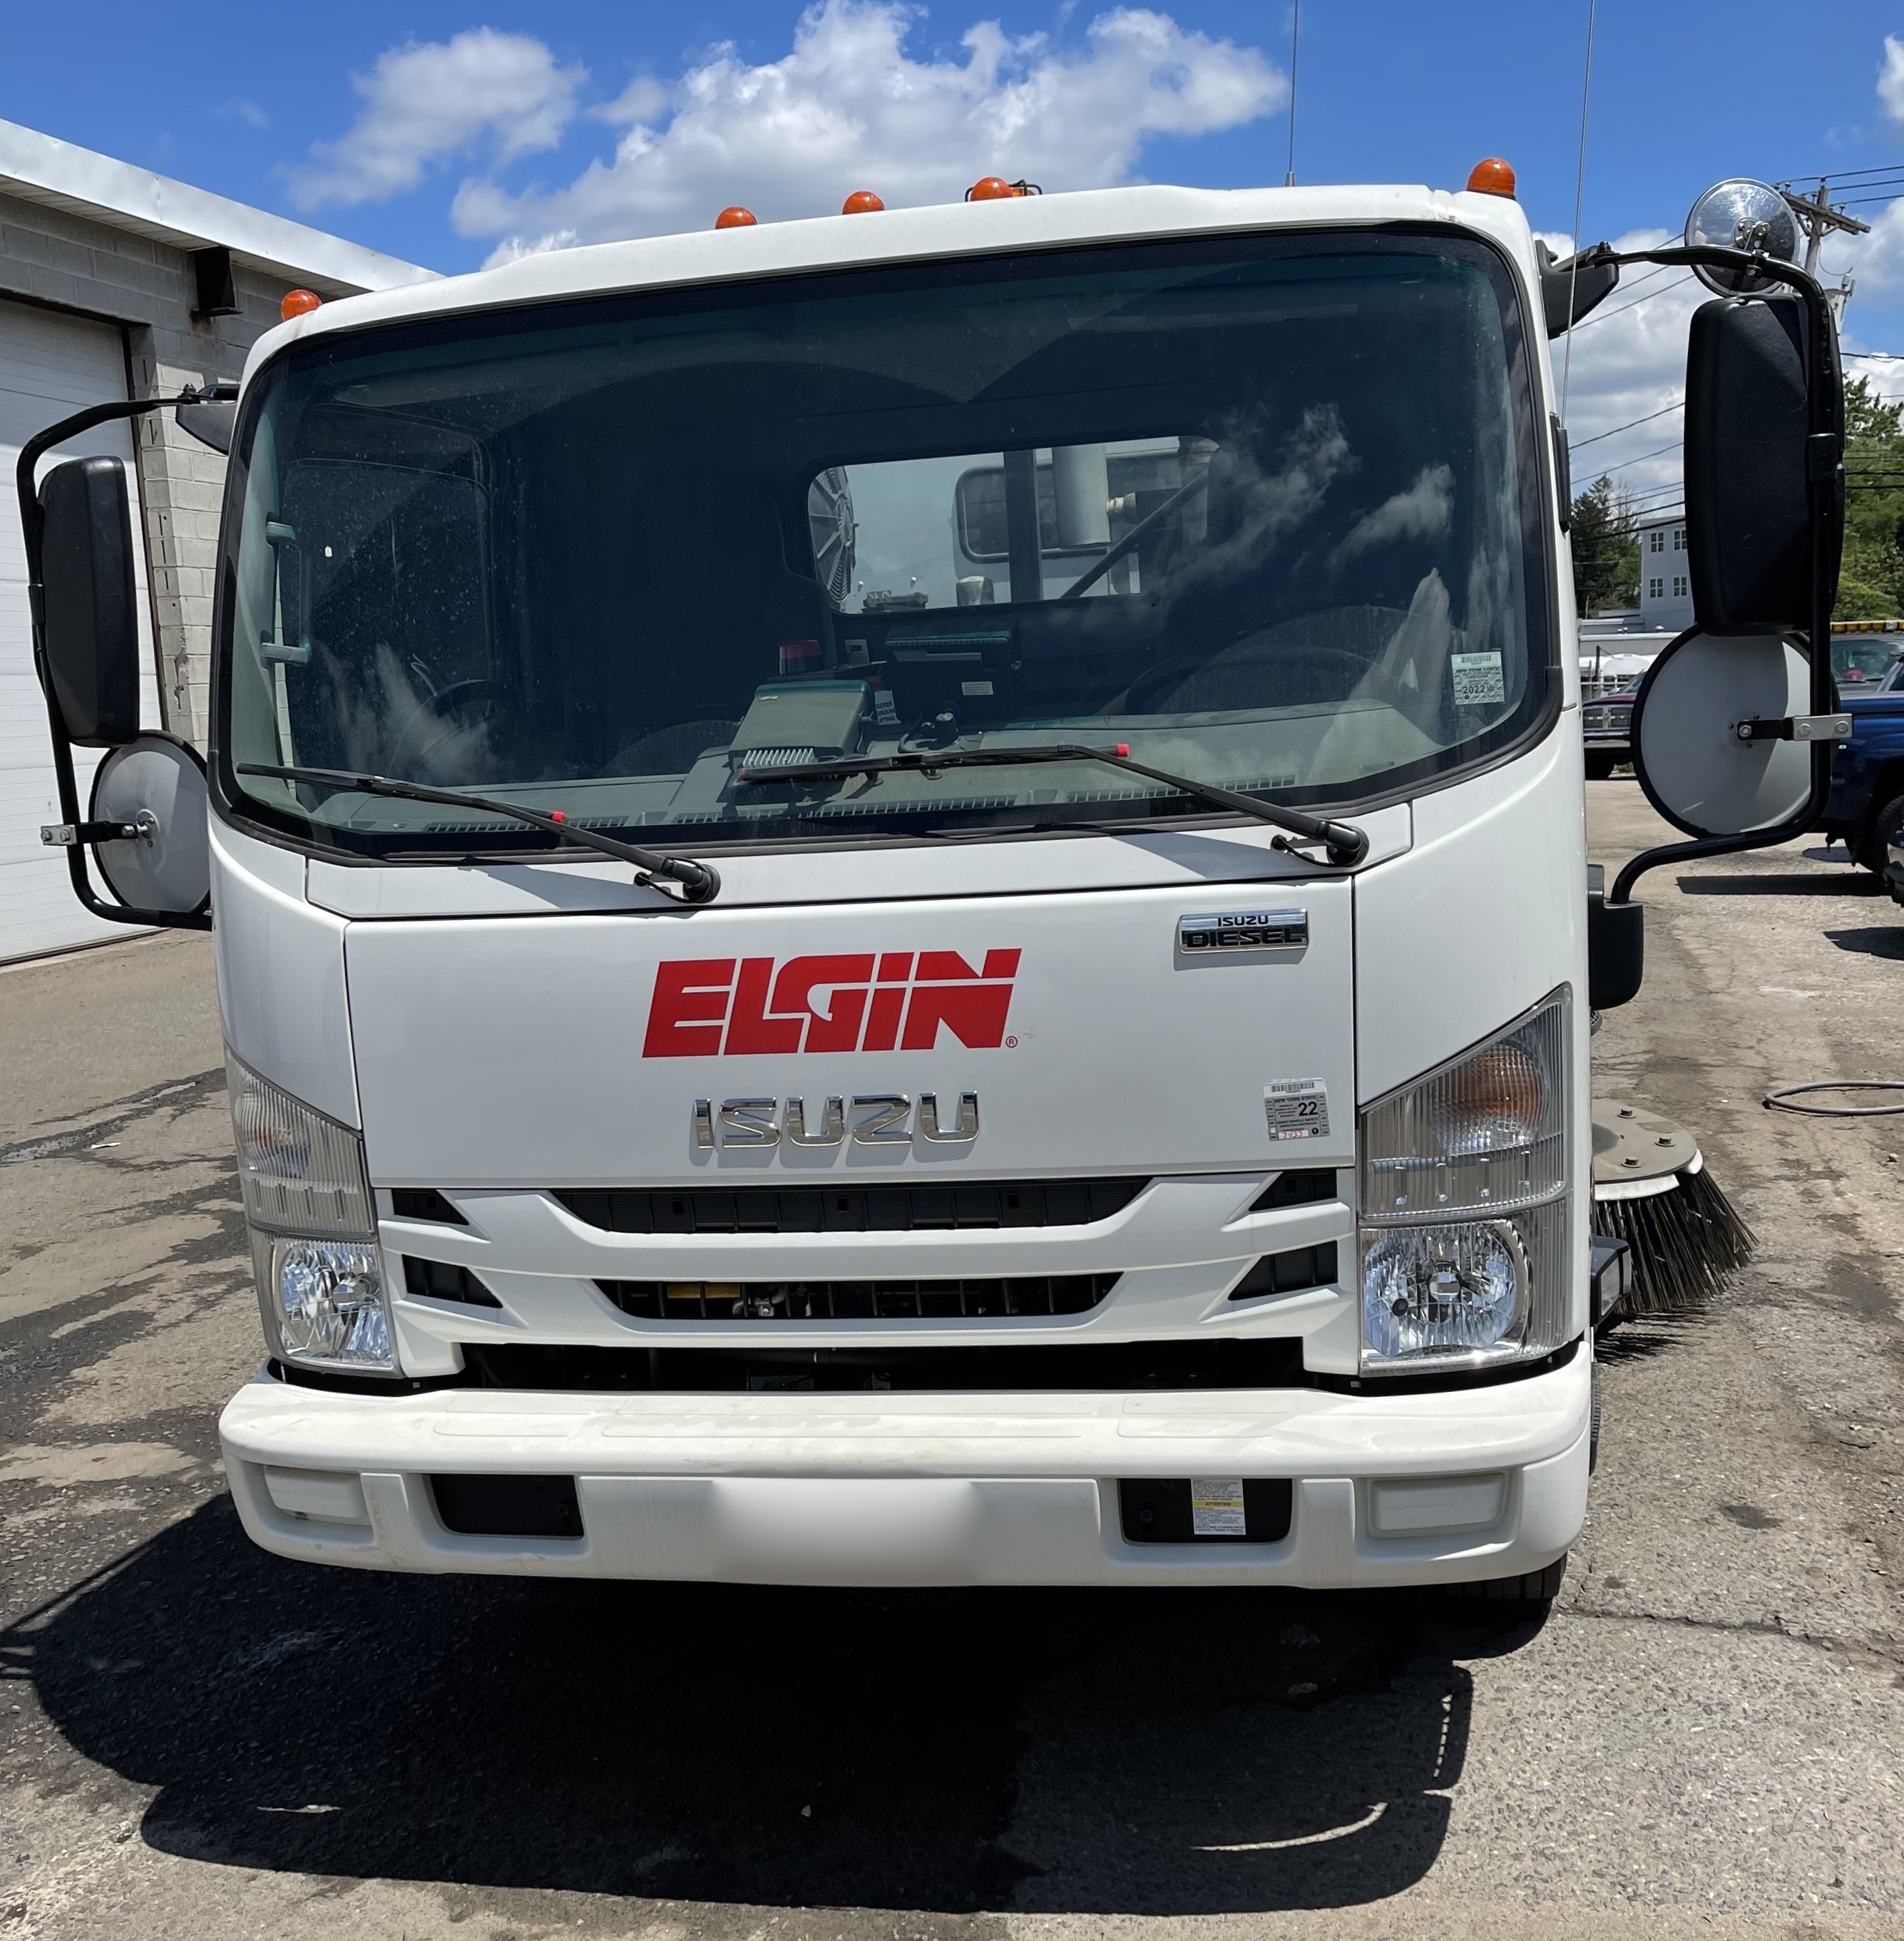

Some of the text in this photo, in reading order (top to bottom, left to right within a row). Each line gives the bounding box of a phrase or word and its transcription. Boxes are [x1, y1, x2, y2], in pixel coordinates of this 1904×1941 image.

[1463, 685, 1485, 694] 2022
[1217, 915, 1269, 927] ISUZU
[1187, 928, 1303, 948] DIESEL
[642, 948, 1022, 1058] ELGIN
[1298, 1102, 1318, 1117] 22
[694, 1090, 980, 1149] ISUZU
